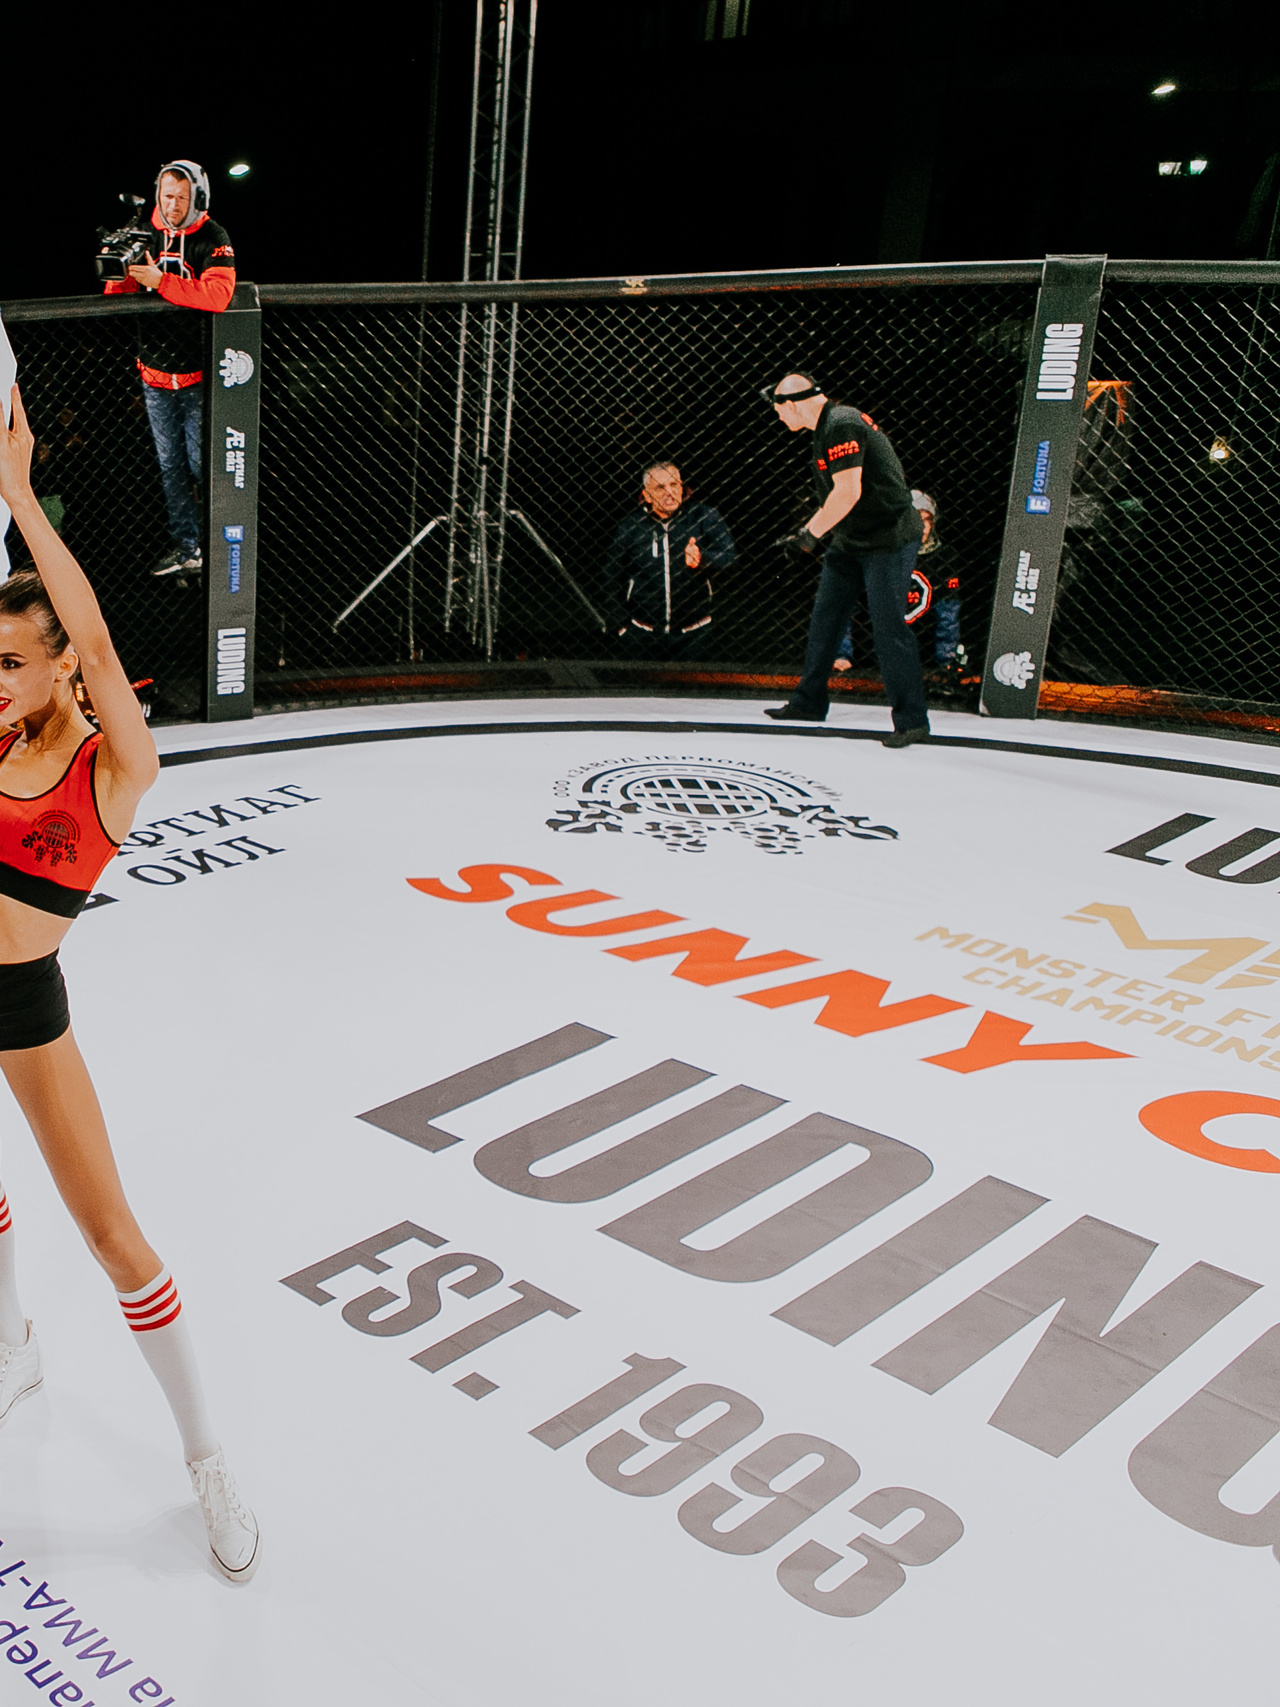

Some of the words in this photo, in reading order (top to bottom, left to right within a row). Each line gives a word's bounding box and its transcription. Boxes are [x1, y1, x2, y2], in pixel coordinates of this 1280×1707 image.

[1036, 323, 1083, 400] LUDING
[1032, 440, 1050, 494] FORTUNA
[230, 544, 241, 594] FORTUNA
[217, 627, 246, 696] LUDING
[127, 835, 288, 886] ОЙЛ
[405, 863, 1140, 1074] SUNNY
[913, 926, 1206, 1013] MONSTER
[278, 1220, 582, 1401] EST.
[527, 1352, 965, 1618] 1993
